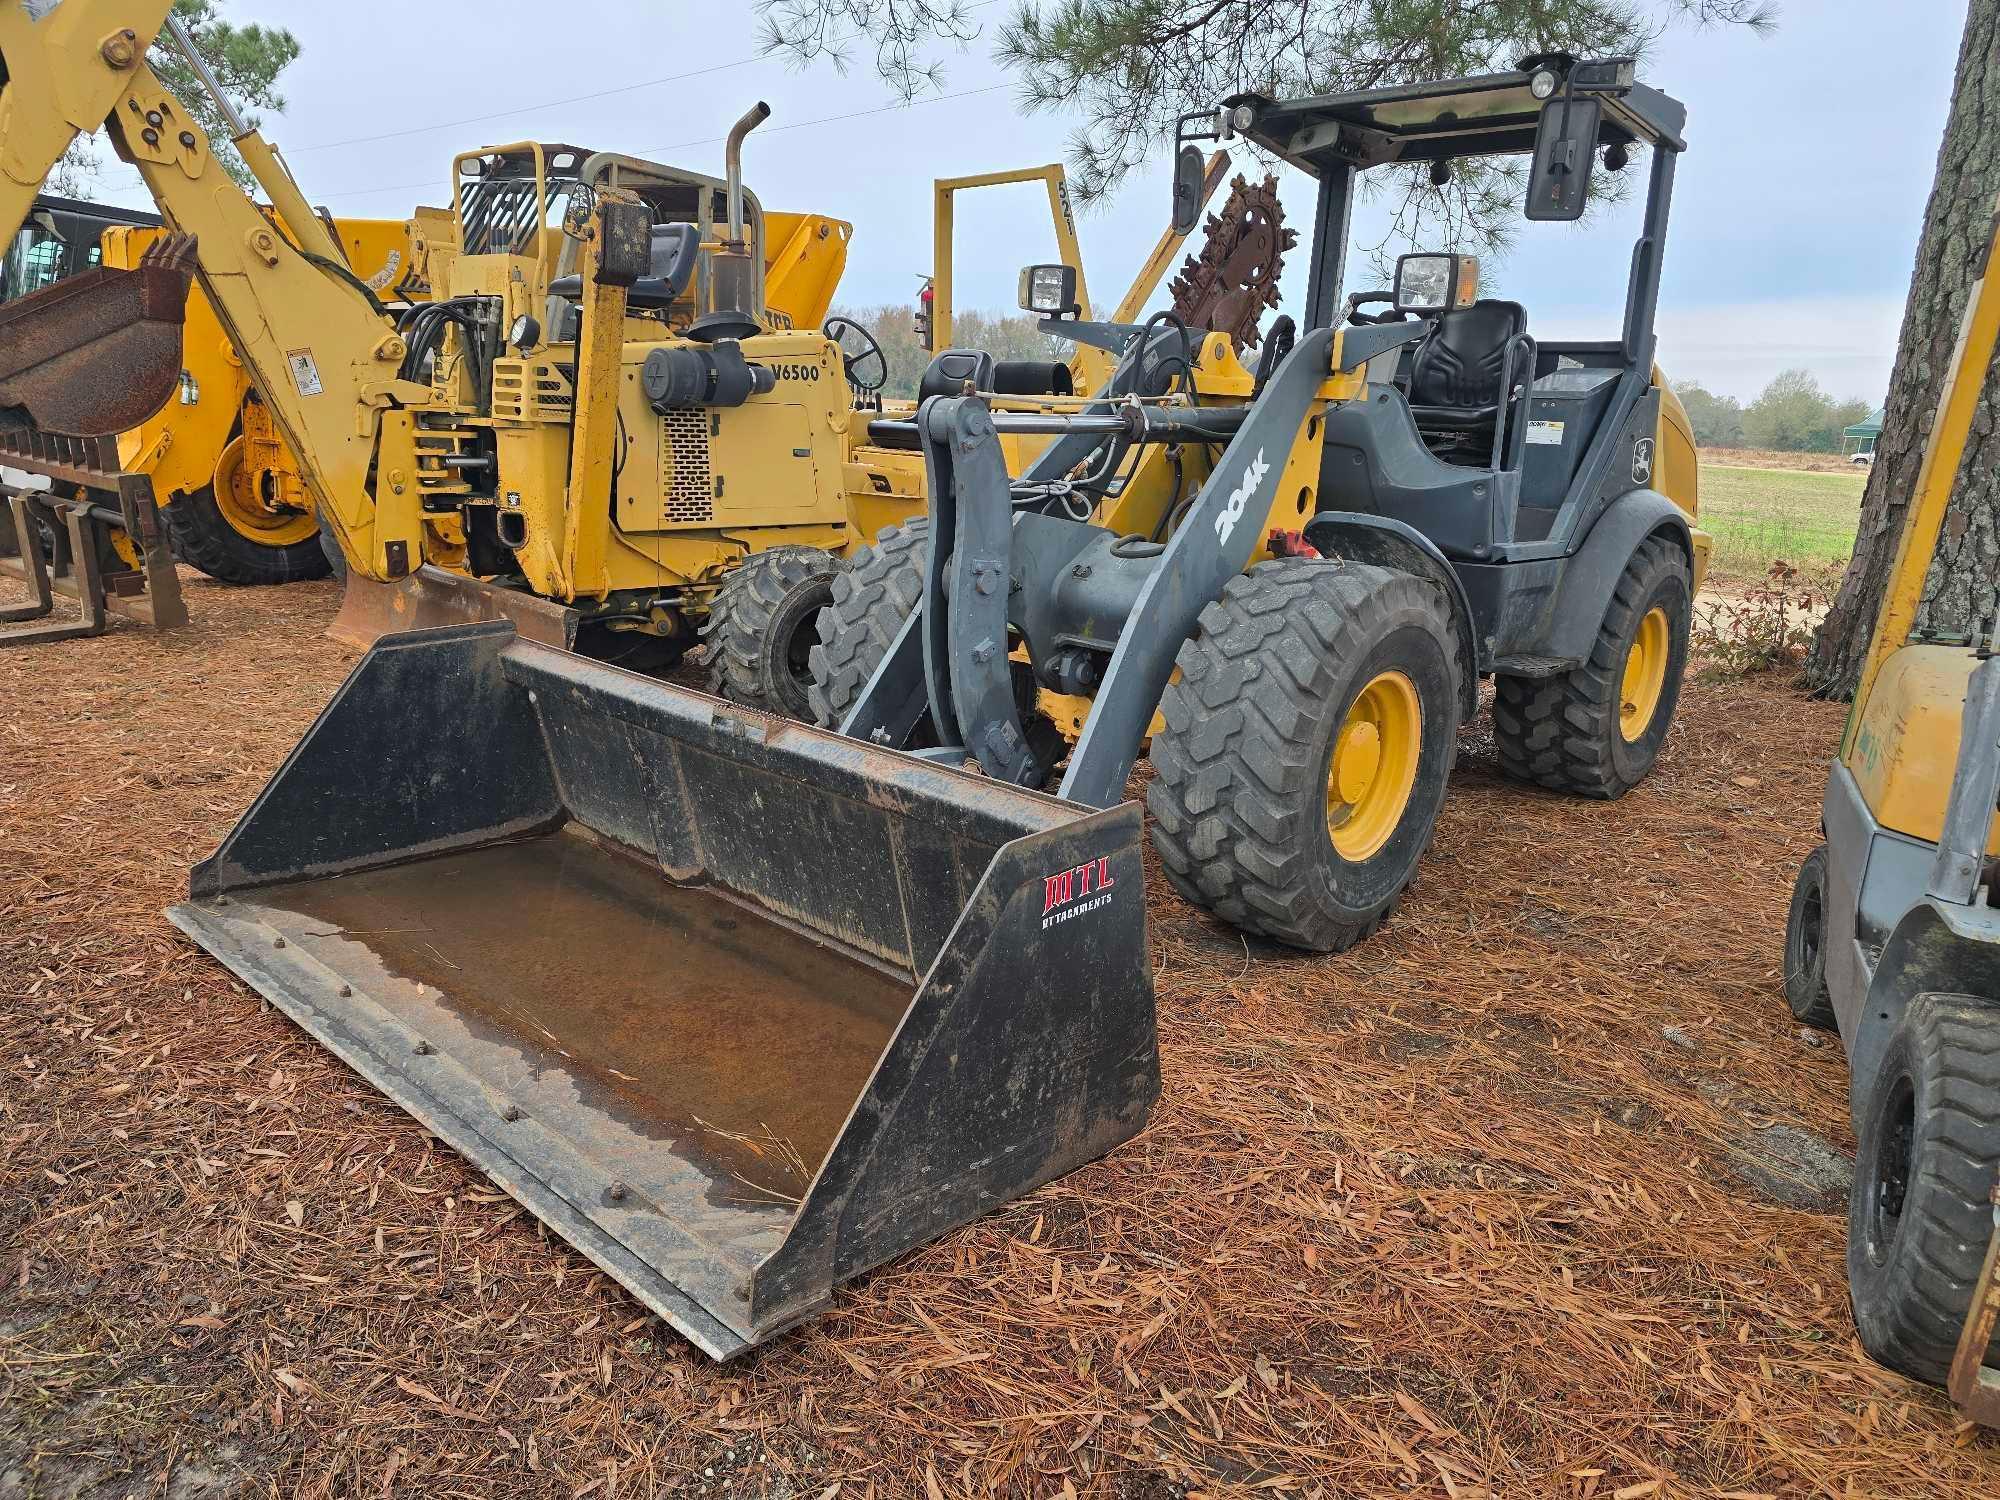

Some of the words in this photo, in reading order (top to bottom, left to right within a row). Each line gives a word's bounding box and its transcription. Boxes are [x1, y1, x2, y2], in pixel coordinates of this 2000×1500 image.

[1058, 181, 1073, 236] 521
[771, 363, 819, 381] V6500
[1214, 445, 1271, 547] 204K
[1041, 893, 1113, 930] ATTACHMENTS
[1042, 855, 1114, 917] MTL
